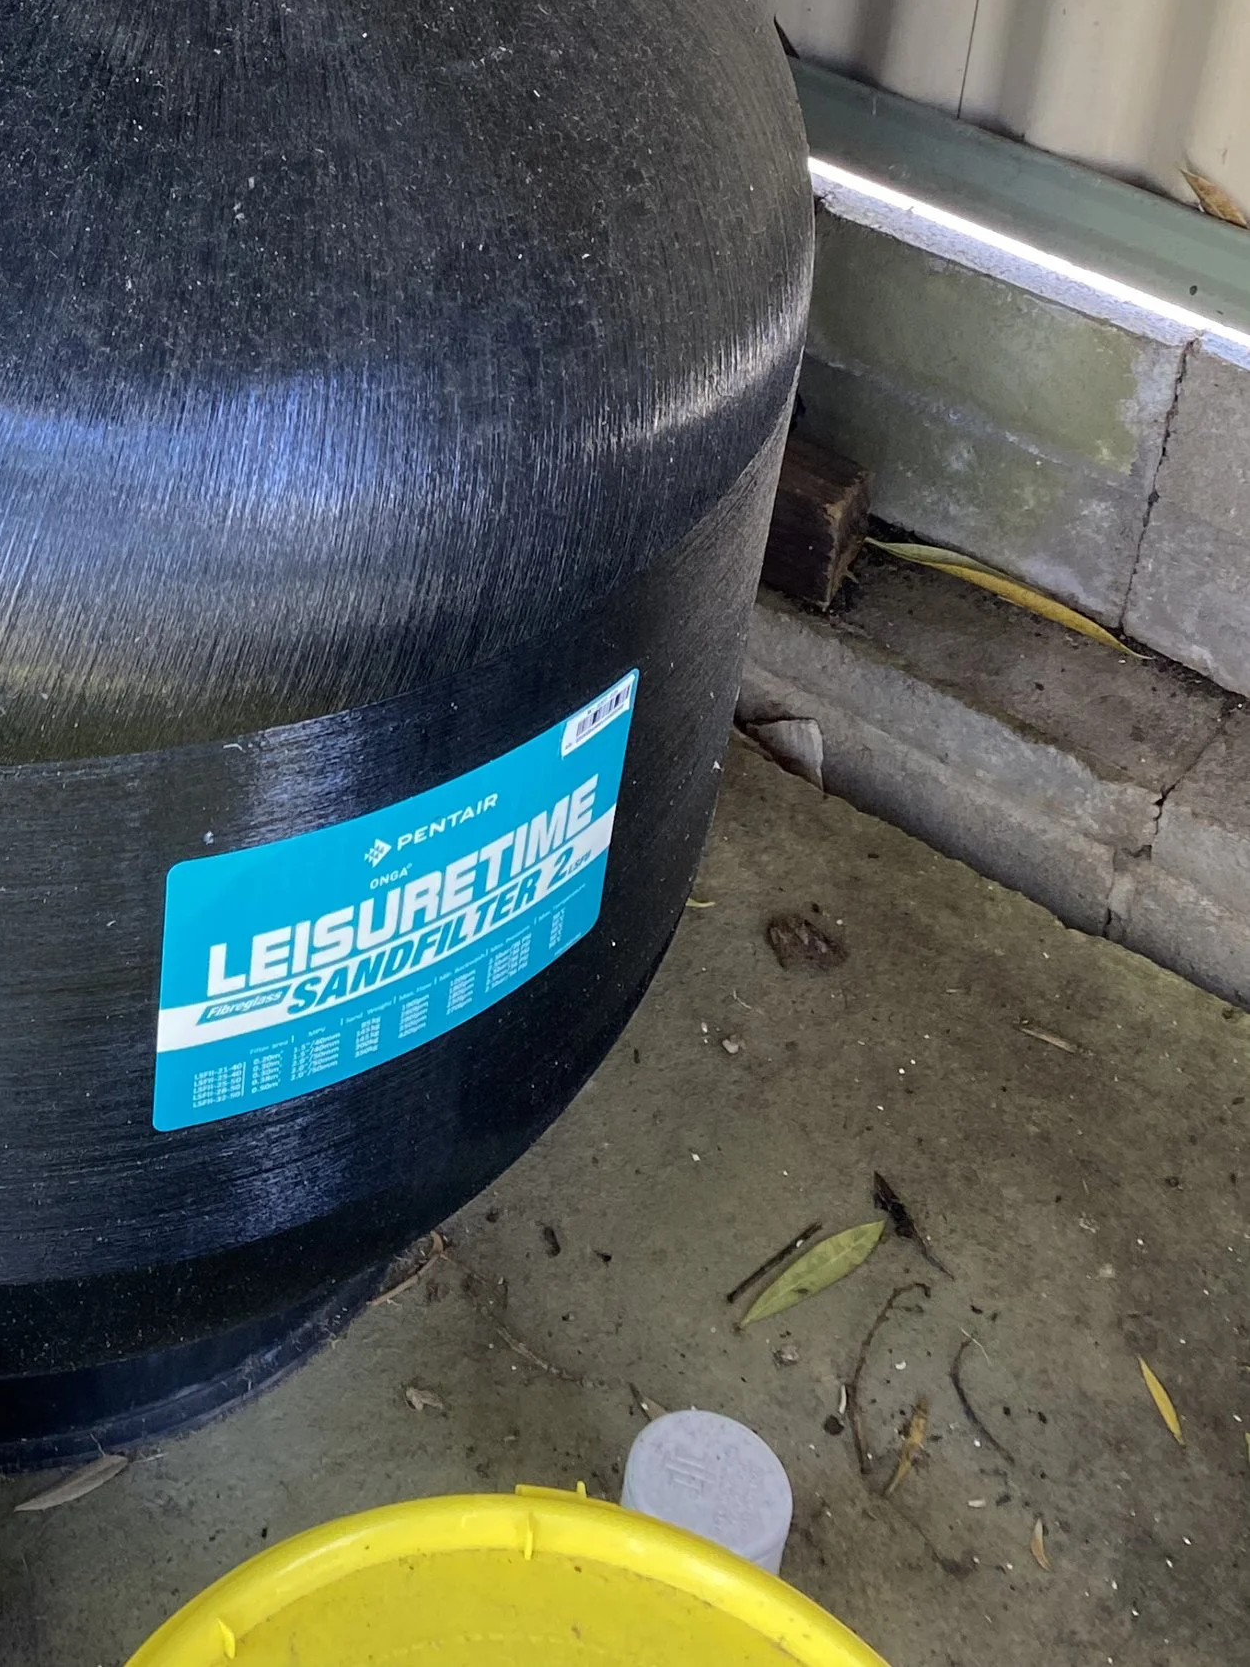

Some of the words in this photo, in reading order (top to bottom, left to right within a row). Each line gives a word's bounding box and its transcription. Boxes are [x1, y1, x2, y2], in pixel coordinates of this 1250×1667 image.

[369, 865, 410, 890] ONGA
[397, 792, 499, 852] PENTAIR
[206, 773, 599, 998] LEISURETIME
[206, 990, 284, 1020] Fibreglass
[286, 864, 544, 1016] SANDFILTER
[546, 846, 575, 892] 2
